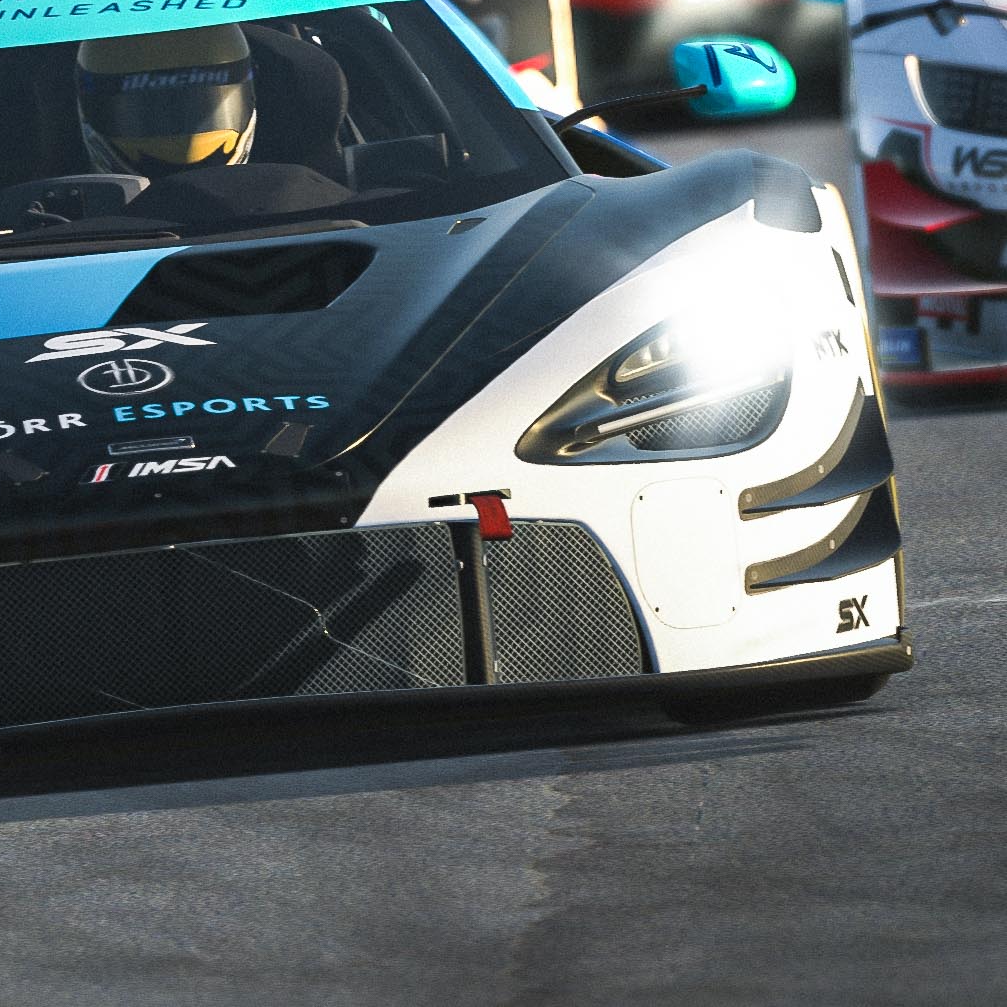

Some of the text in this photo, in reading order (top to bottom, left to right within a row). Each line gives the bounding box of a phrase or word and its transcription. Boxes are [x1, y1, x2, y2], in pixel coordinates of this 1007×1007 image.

[24, 322, 218, 363] SX
[112, 394, 331, 423] ESPORTS
[127, 454, 237, 479] IMSA
[835, 594, 870, 634] SX
